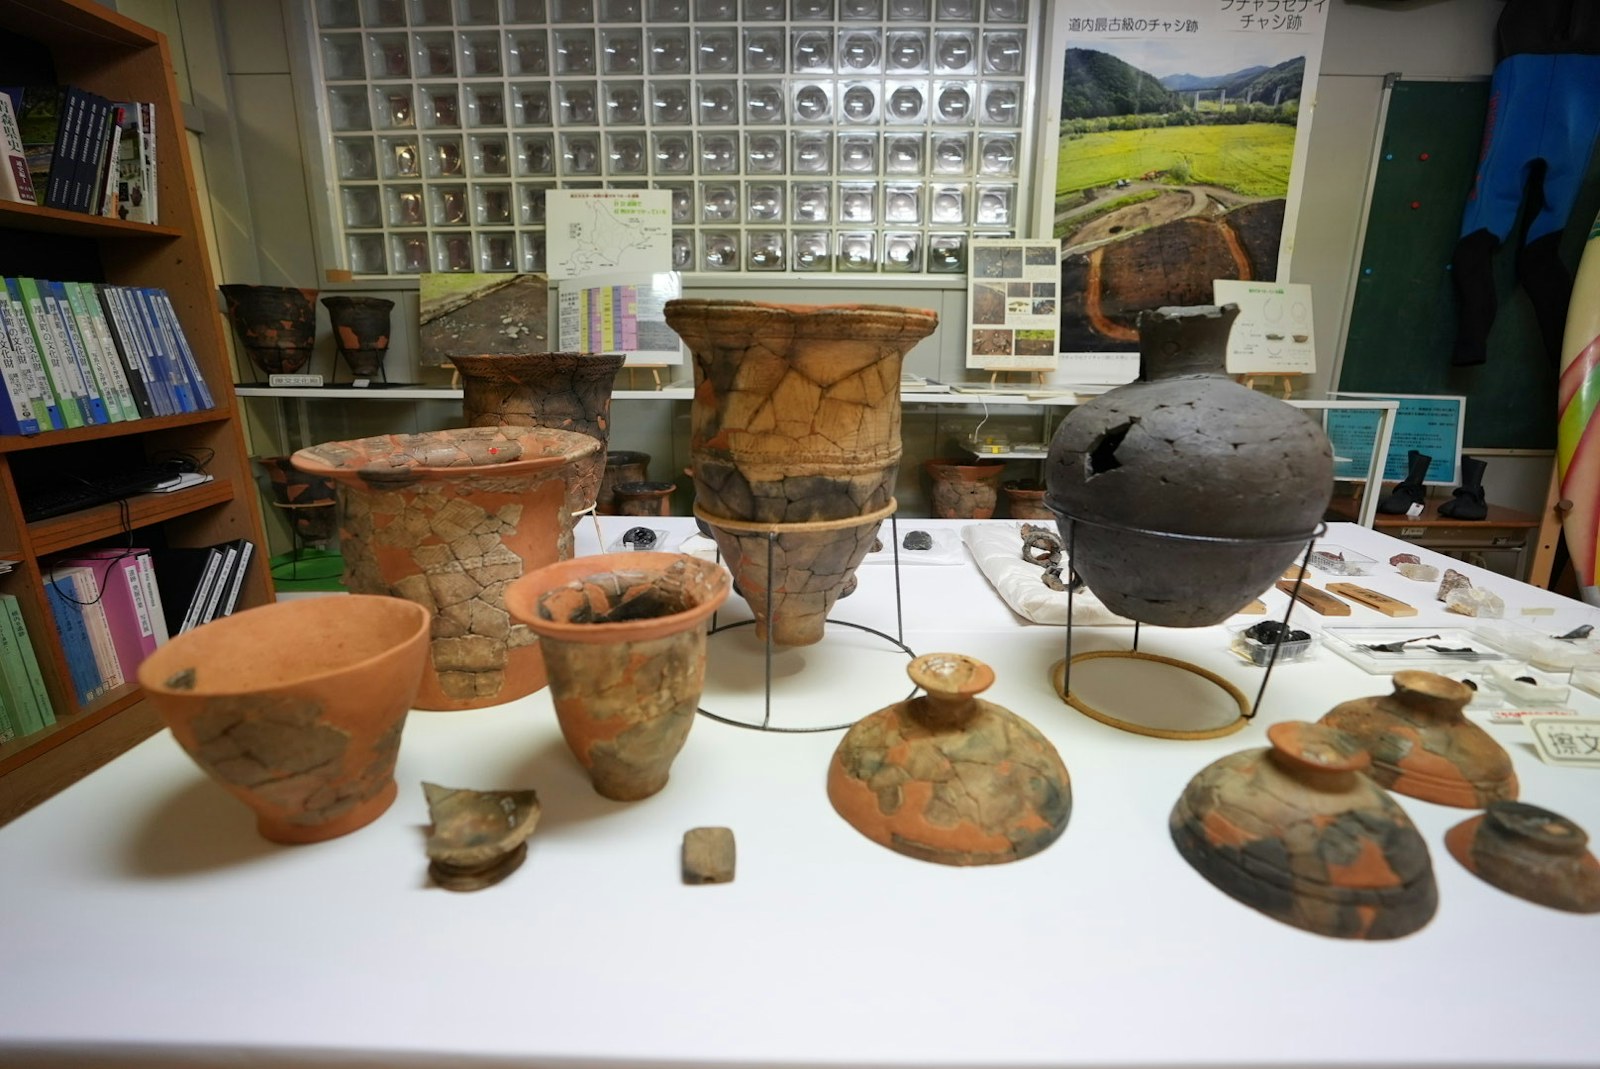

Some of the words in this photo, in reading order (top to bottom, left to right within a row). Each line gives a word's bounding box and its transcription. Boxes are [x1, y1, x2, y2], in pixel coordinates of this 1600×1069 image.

[1068, 17, 1199, 33] 道内最古級のチャシ跡
[1240, 14, 1302, 31] チャシ跡
